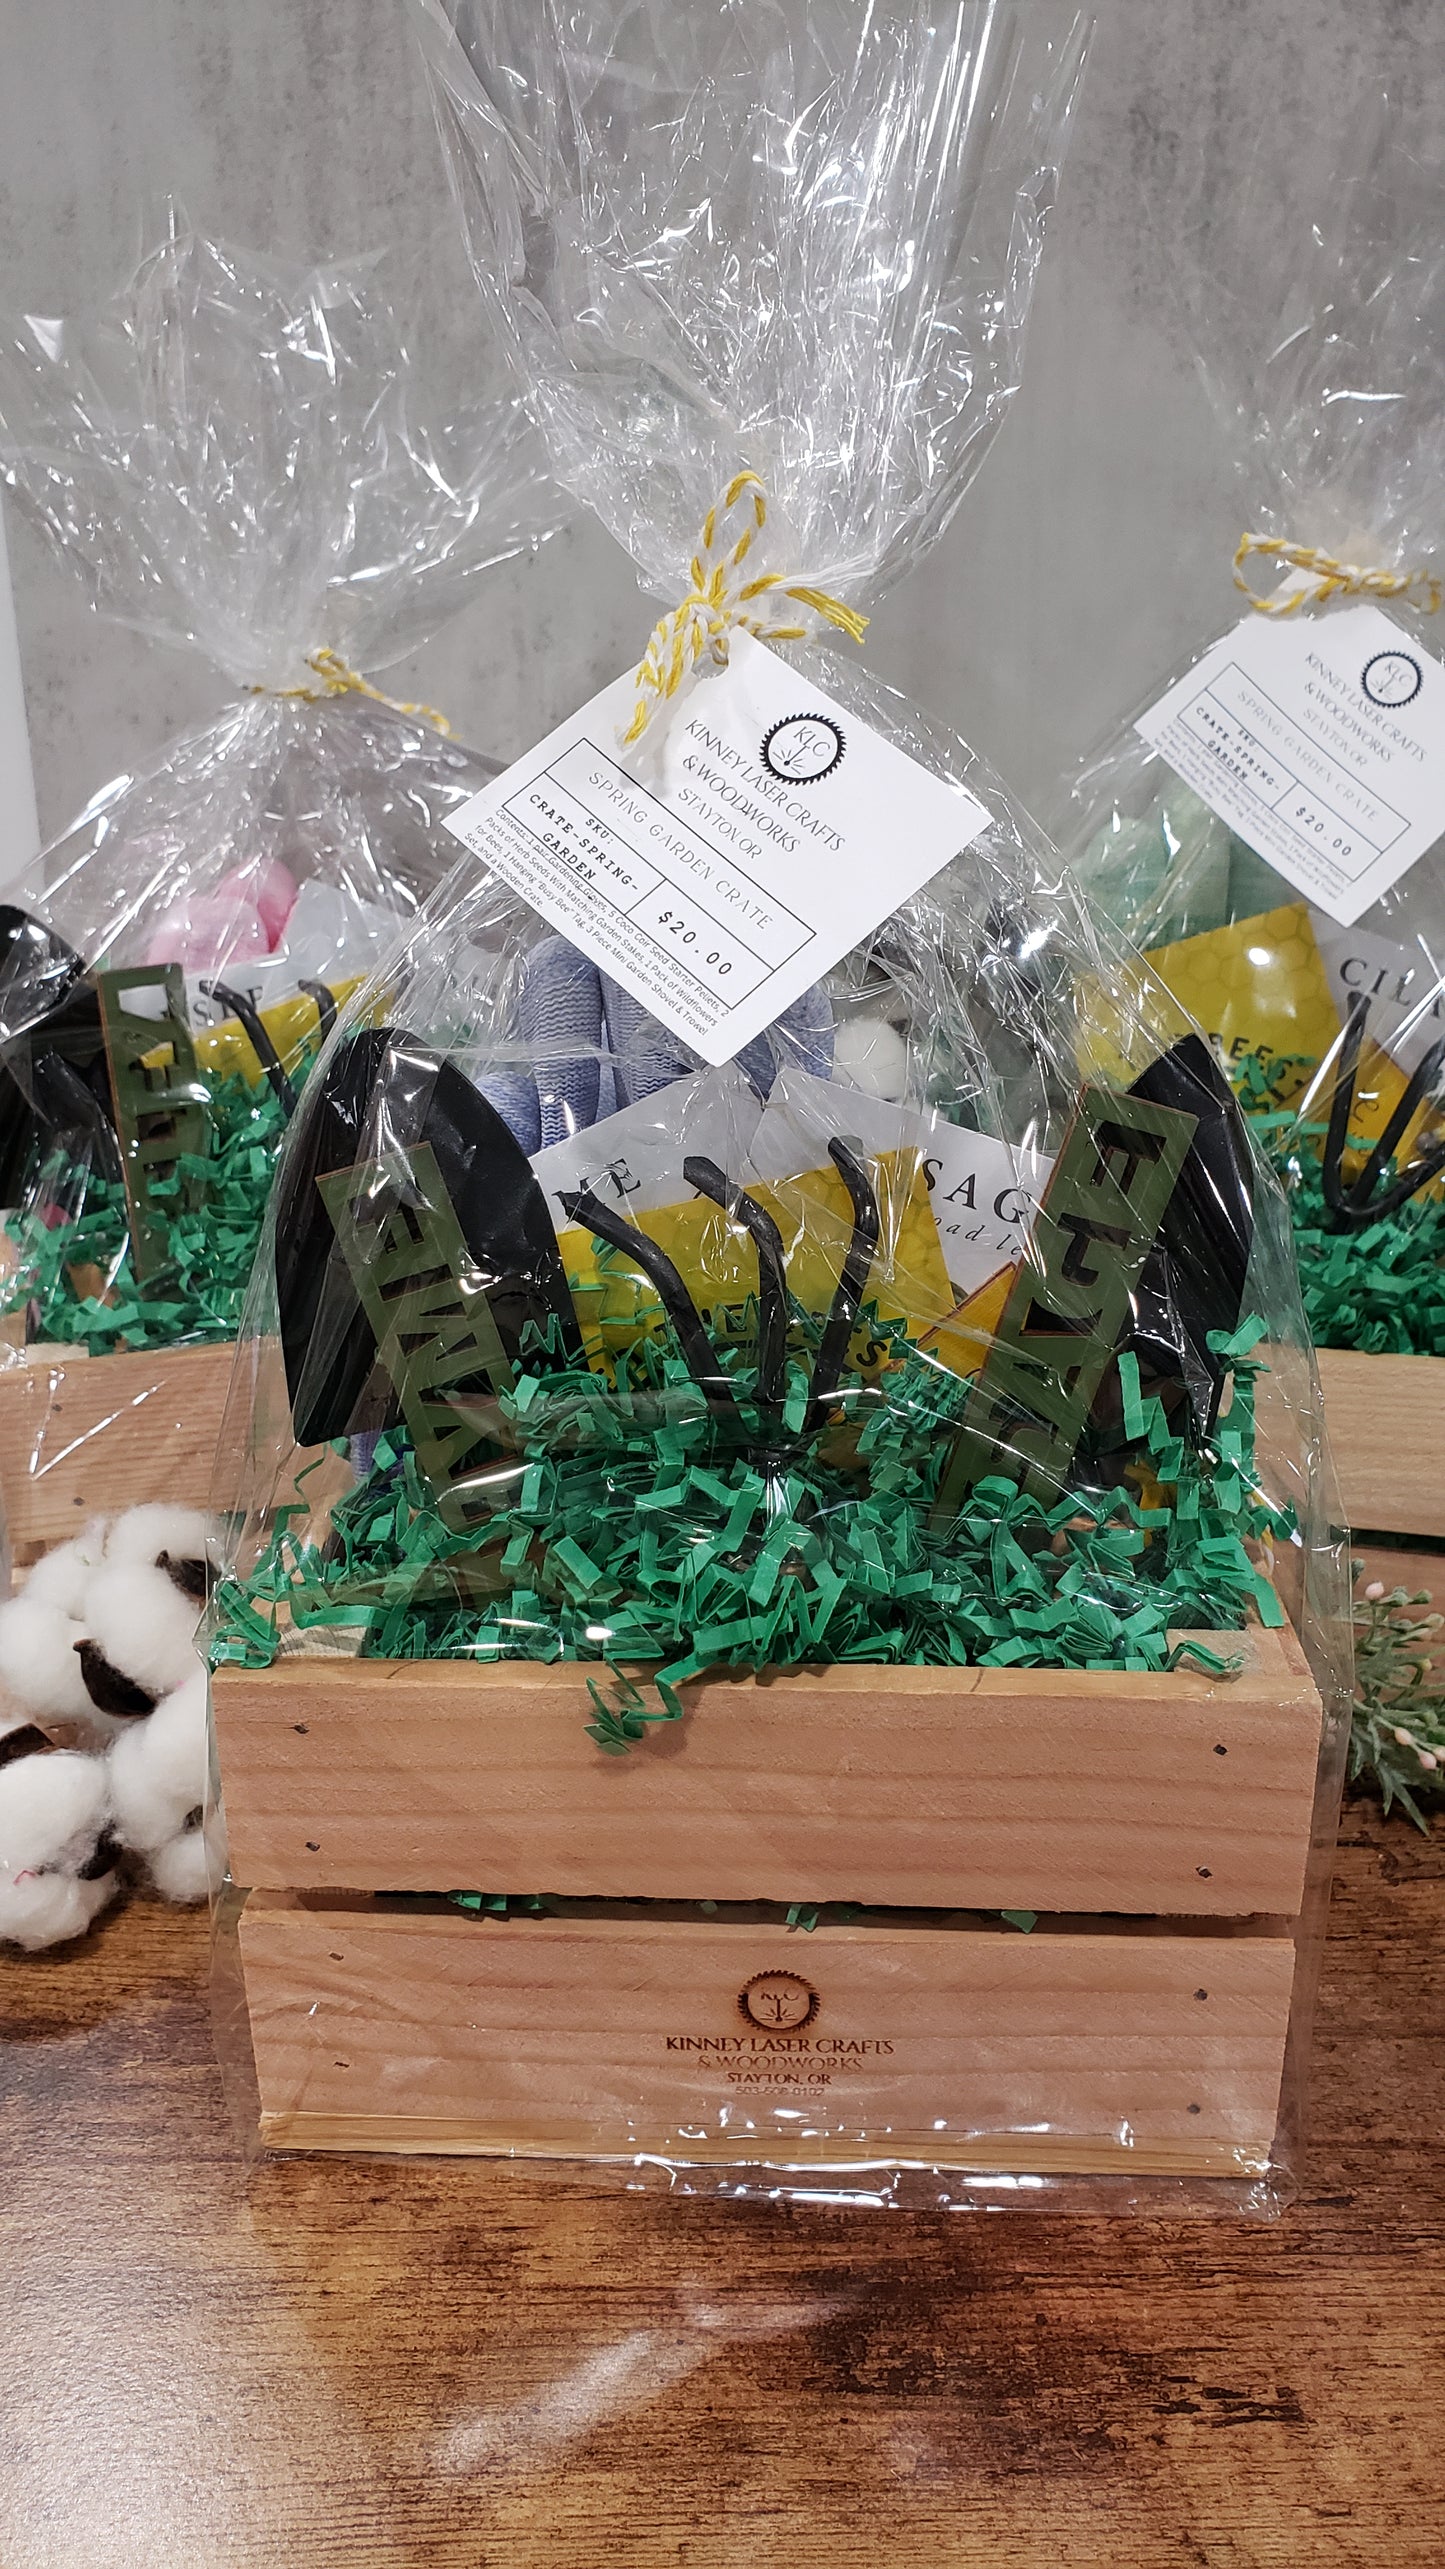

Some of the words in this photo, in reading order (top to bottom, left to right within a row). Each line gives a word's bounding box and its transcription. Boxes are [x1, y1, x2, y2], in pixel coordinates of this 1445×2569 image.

[1304, 652, 1351, 696] KINNEY
[1346, 692, 1384, 726] LASER
[793, 726, 831, 757] KLC
[1195, 706, 1280, 790] CRATE-SPRING-
[1206, 739, 1248, 780] GARDEN
[1236, 690, 1284, 736] SPRING
[1282, 735, 1334, 784] GARDEN
[1334, 782, 1378, 822] CRATE
[682, 755, 699, 772] &
[697, 764, 800, 852] WOODWORKS
[685, 719, 747, 769] KINNEY
[740, 766, 788, 807] LASER
[785, 802, 845, 851] CRAFTS
[530, 794, 637, 889] CRATE-SPRING-
[543, 833, 596, 880] GARDEN
[585, 818, 614, 845] SKU:
[589, 772, 648, 823] SPRING
[649, 824, 714, 880] GARDEN
[715, 880, 773, 929] CRATE
[738, 838, 762, 859] OR
[1294, 806, 1352, 856] $20.00
[477, 846, 494, 860] and
[496, 861, 525, 889] Wooden
[474, 824, 488, 836] for
[503, 851, 512, 859] 1
[508, 855, 538, 884] Hanging
[585, 925, 595, 934] 3
[591, 930, 612, 951] Piece
[626, 961, 653, 986] Garden
[651, 983, 679, 1009] Shovel
[675, 1006, 684, 1015] &
[682, 1010, 709, 1036] Trowel
[484, 816, 506, 837] Packs
[504, 835, 516, 844] of
[511, 841, 531, 860] Herb
[528, 856, 551, 878] Seeds
[566, 889, 598, 921] Matching
[596, 917, 622, 942] Garden
[644, 960, 653, 968] 1
[650, 964, 669, 984] Pack
[666, 981, 679, 990] of
[676, 987, 718, 1027] Wildflowers
[495, 809, 529, 841] Contents:
[527, 838, 535, 846] 1
[547, 857, 584, 891] Gardening
[607, 910, 617, 918] 5
[615, 916, 635, 934] Coco
[633, 932, 651, 948] Coir
[649, 946, 671, 965] Seed
[668, 962, 696, 987] Starter
[694, 985, 720, 1013] Pellets,
[720, 1009, 730, 1018] 2
[658, 911, 732, 975] $20.00
[922, 1158, 1034, 1224] SAG
[666, 2036, 746, 2051] KINNEY
[751, 2038, 810, 2053] LASER
[816, 2039, 895, 2054] CRAFTS
[699, 2055, 711, 2069] &
[716, 2055, 864, 2072] WOODWORKS
[808, 2073, 833, 2085] OR
